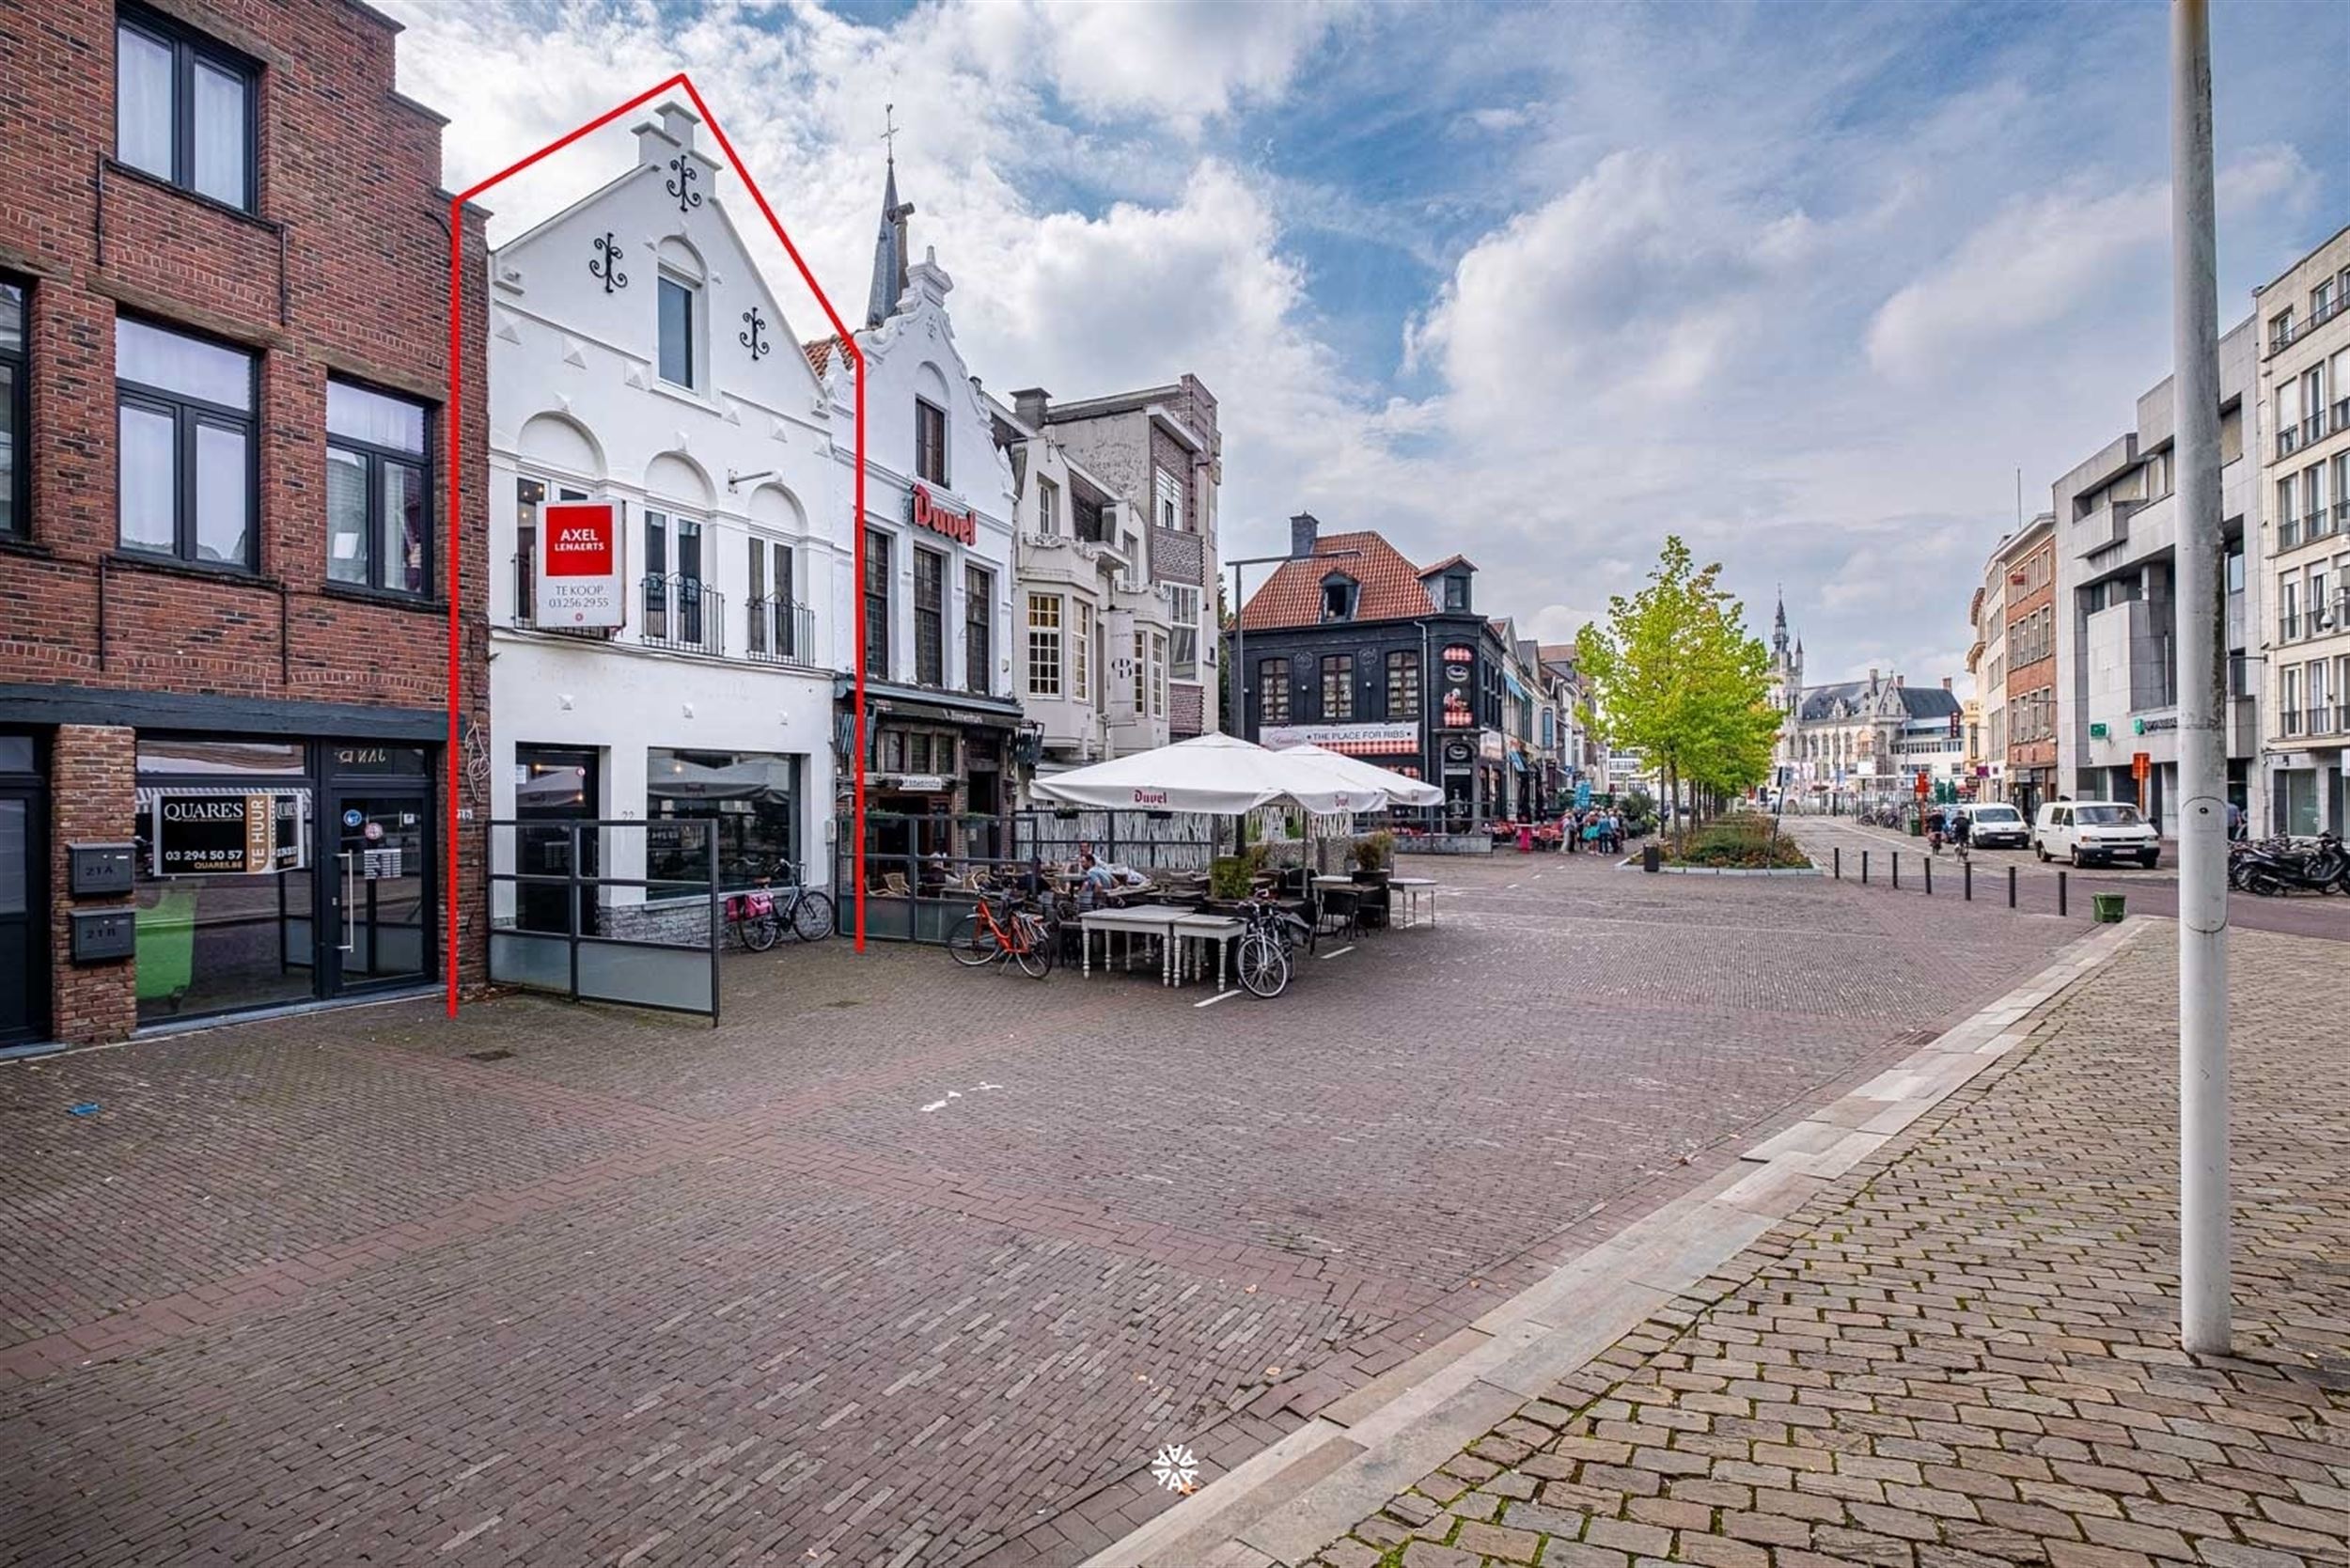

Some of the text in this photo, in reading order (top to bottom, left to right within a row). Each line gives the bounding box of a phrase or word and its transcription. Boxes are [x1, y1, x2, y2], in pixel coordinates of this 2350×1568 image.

[913, 483, 977, 546] Duvel
[560, 529, 598, 541] AXEL
[555, 542, 604, 552] LENAERTS
[556, 586, 603, 596] TE KOOP
[549, 597, 609, 608] 03 256 29 55
[1332, 731, 1360, 741] PLACE
[1363, 731, 1381, 740] FOR
[1384, 730, 1404, 739] RIBS
[1135, 790, 1167, 804] Duvel
[164, 803, 243, 821] QUARES
[251, 800, 265, 866] TE HUUR
[165, 850, 243, 860] 03 294 50 57
[86, 866, 113, 876] 21A
